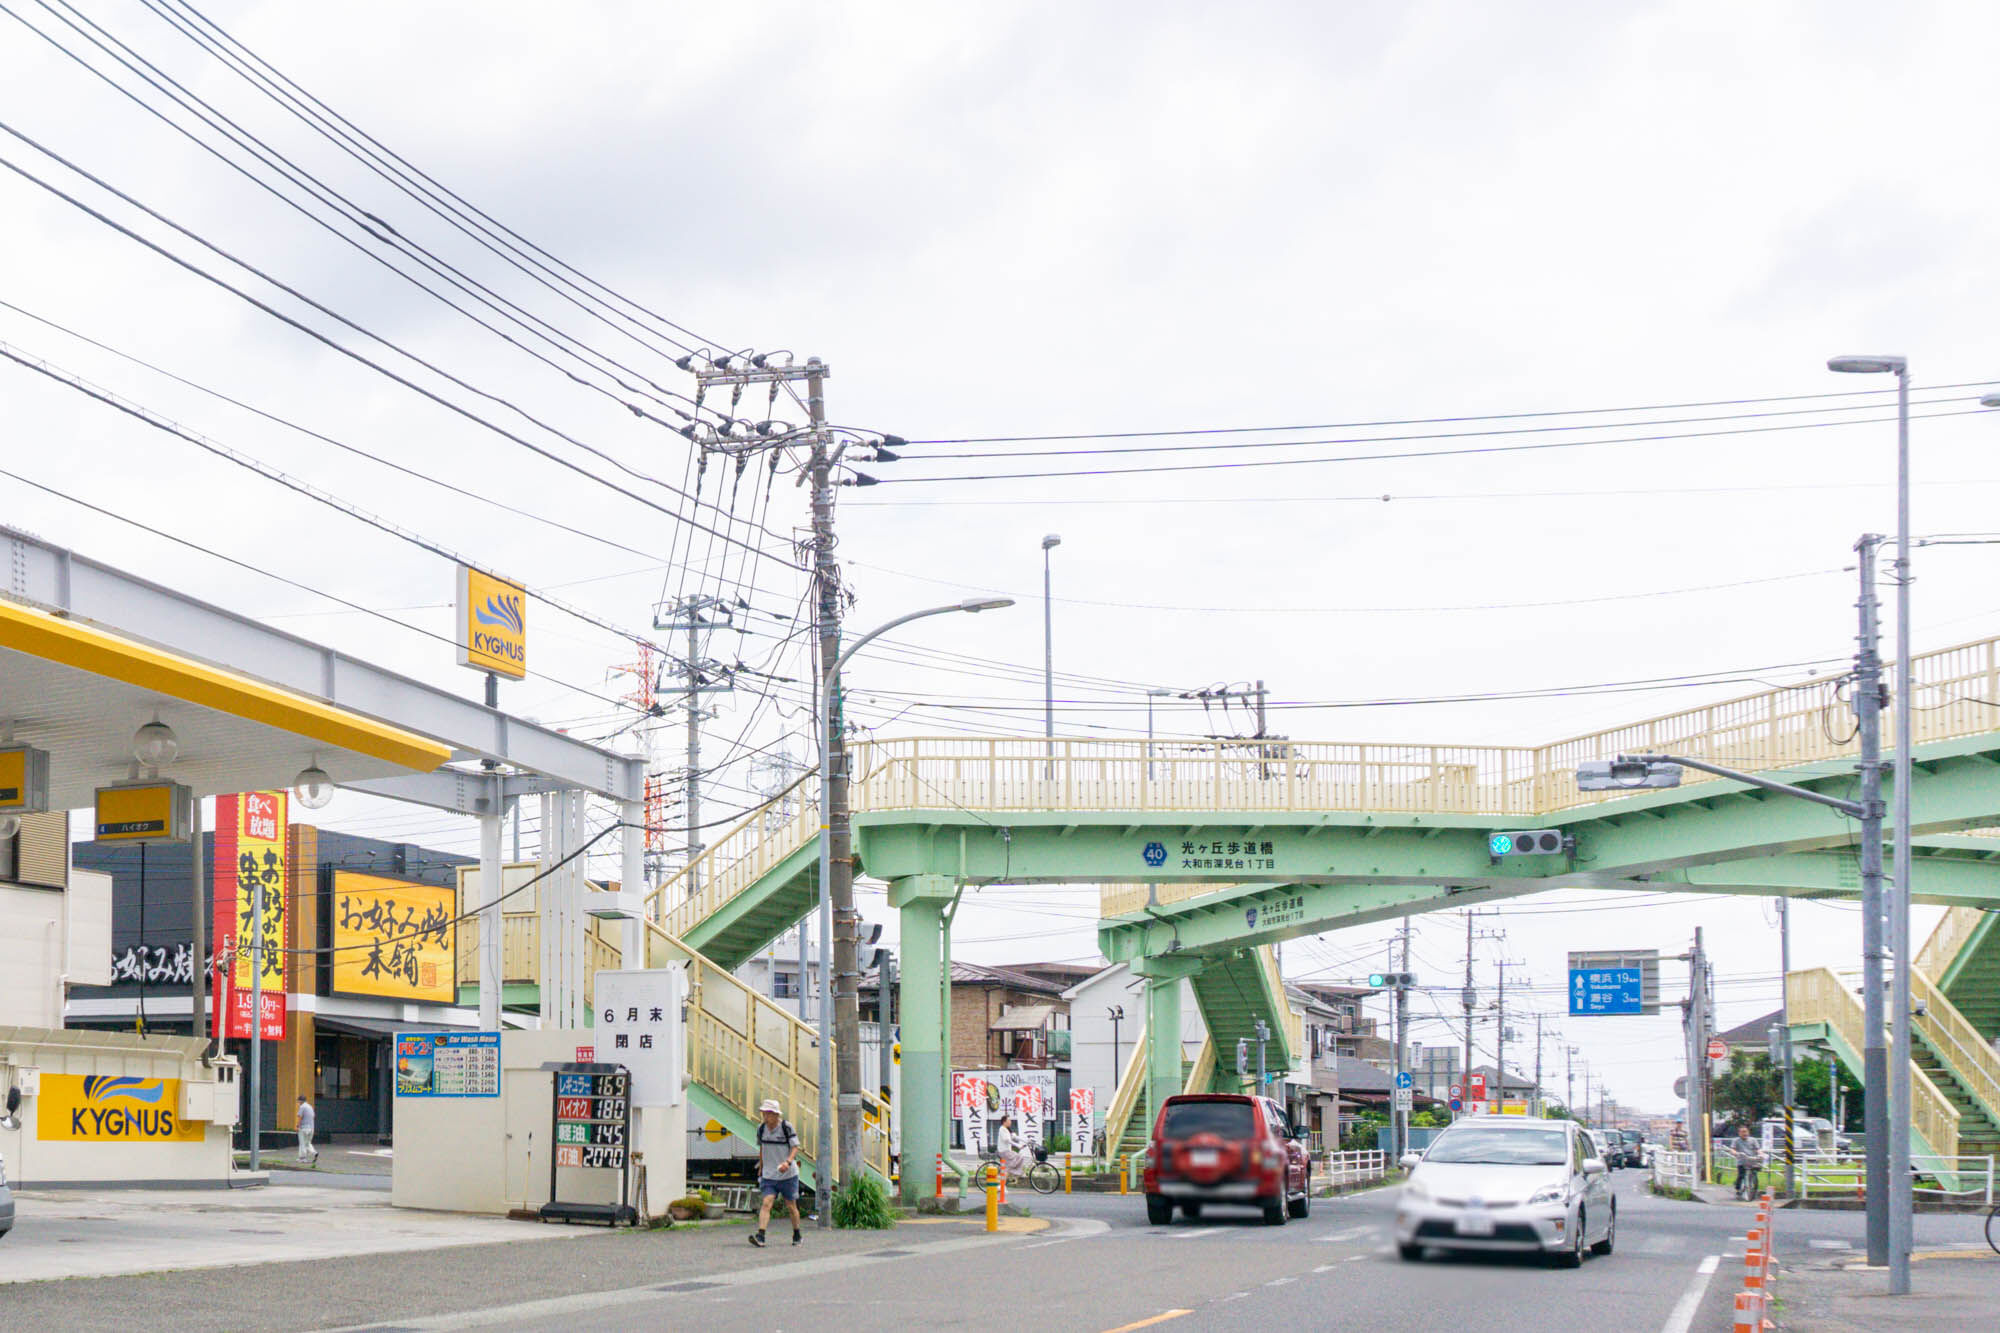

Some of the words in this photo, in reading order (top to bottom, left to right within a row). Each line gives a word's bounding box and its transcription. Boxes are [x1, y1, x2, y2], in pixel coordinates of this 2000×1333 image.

[474, 631, 524, 662] KYGNUS
[121, 823, 150, 832] ハイオク
[1147, 849, 1163, 860] 40
[340, 896, 449, 951] お好み焼
[361, 937, 418, 987] 本舗
[398, 1042, 427, 1055] FK-2
[560, 1076, 591, 1094] レギュラー
[599, 1076, 626, 1096] 169
[559, 1100, 587, 1117] ハイオク
[598, 1099, 625, 1119] 180
[72, 1106, 173, 1136] KYGNUS
[1024, 1112, 1039, 1144] メニュ
[558, 1124, 585, 1143] 軽油
[597, 1125, 623, 1145] 145
[558, 1148, 578, 1166] 灯油
[583, 1147, 624, 1168] 2070
